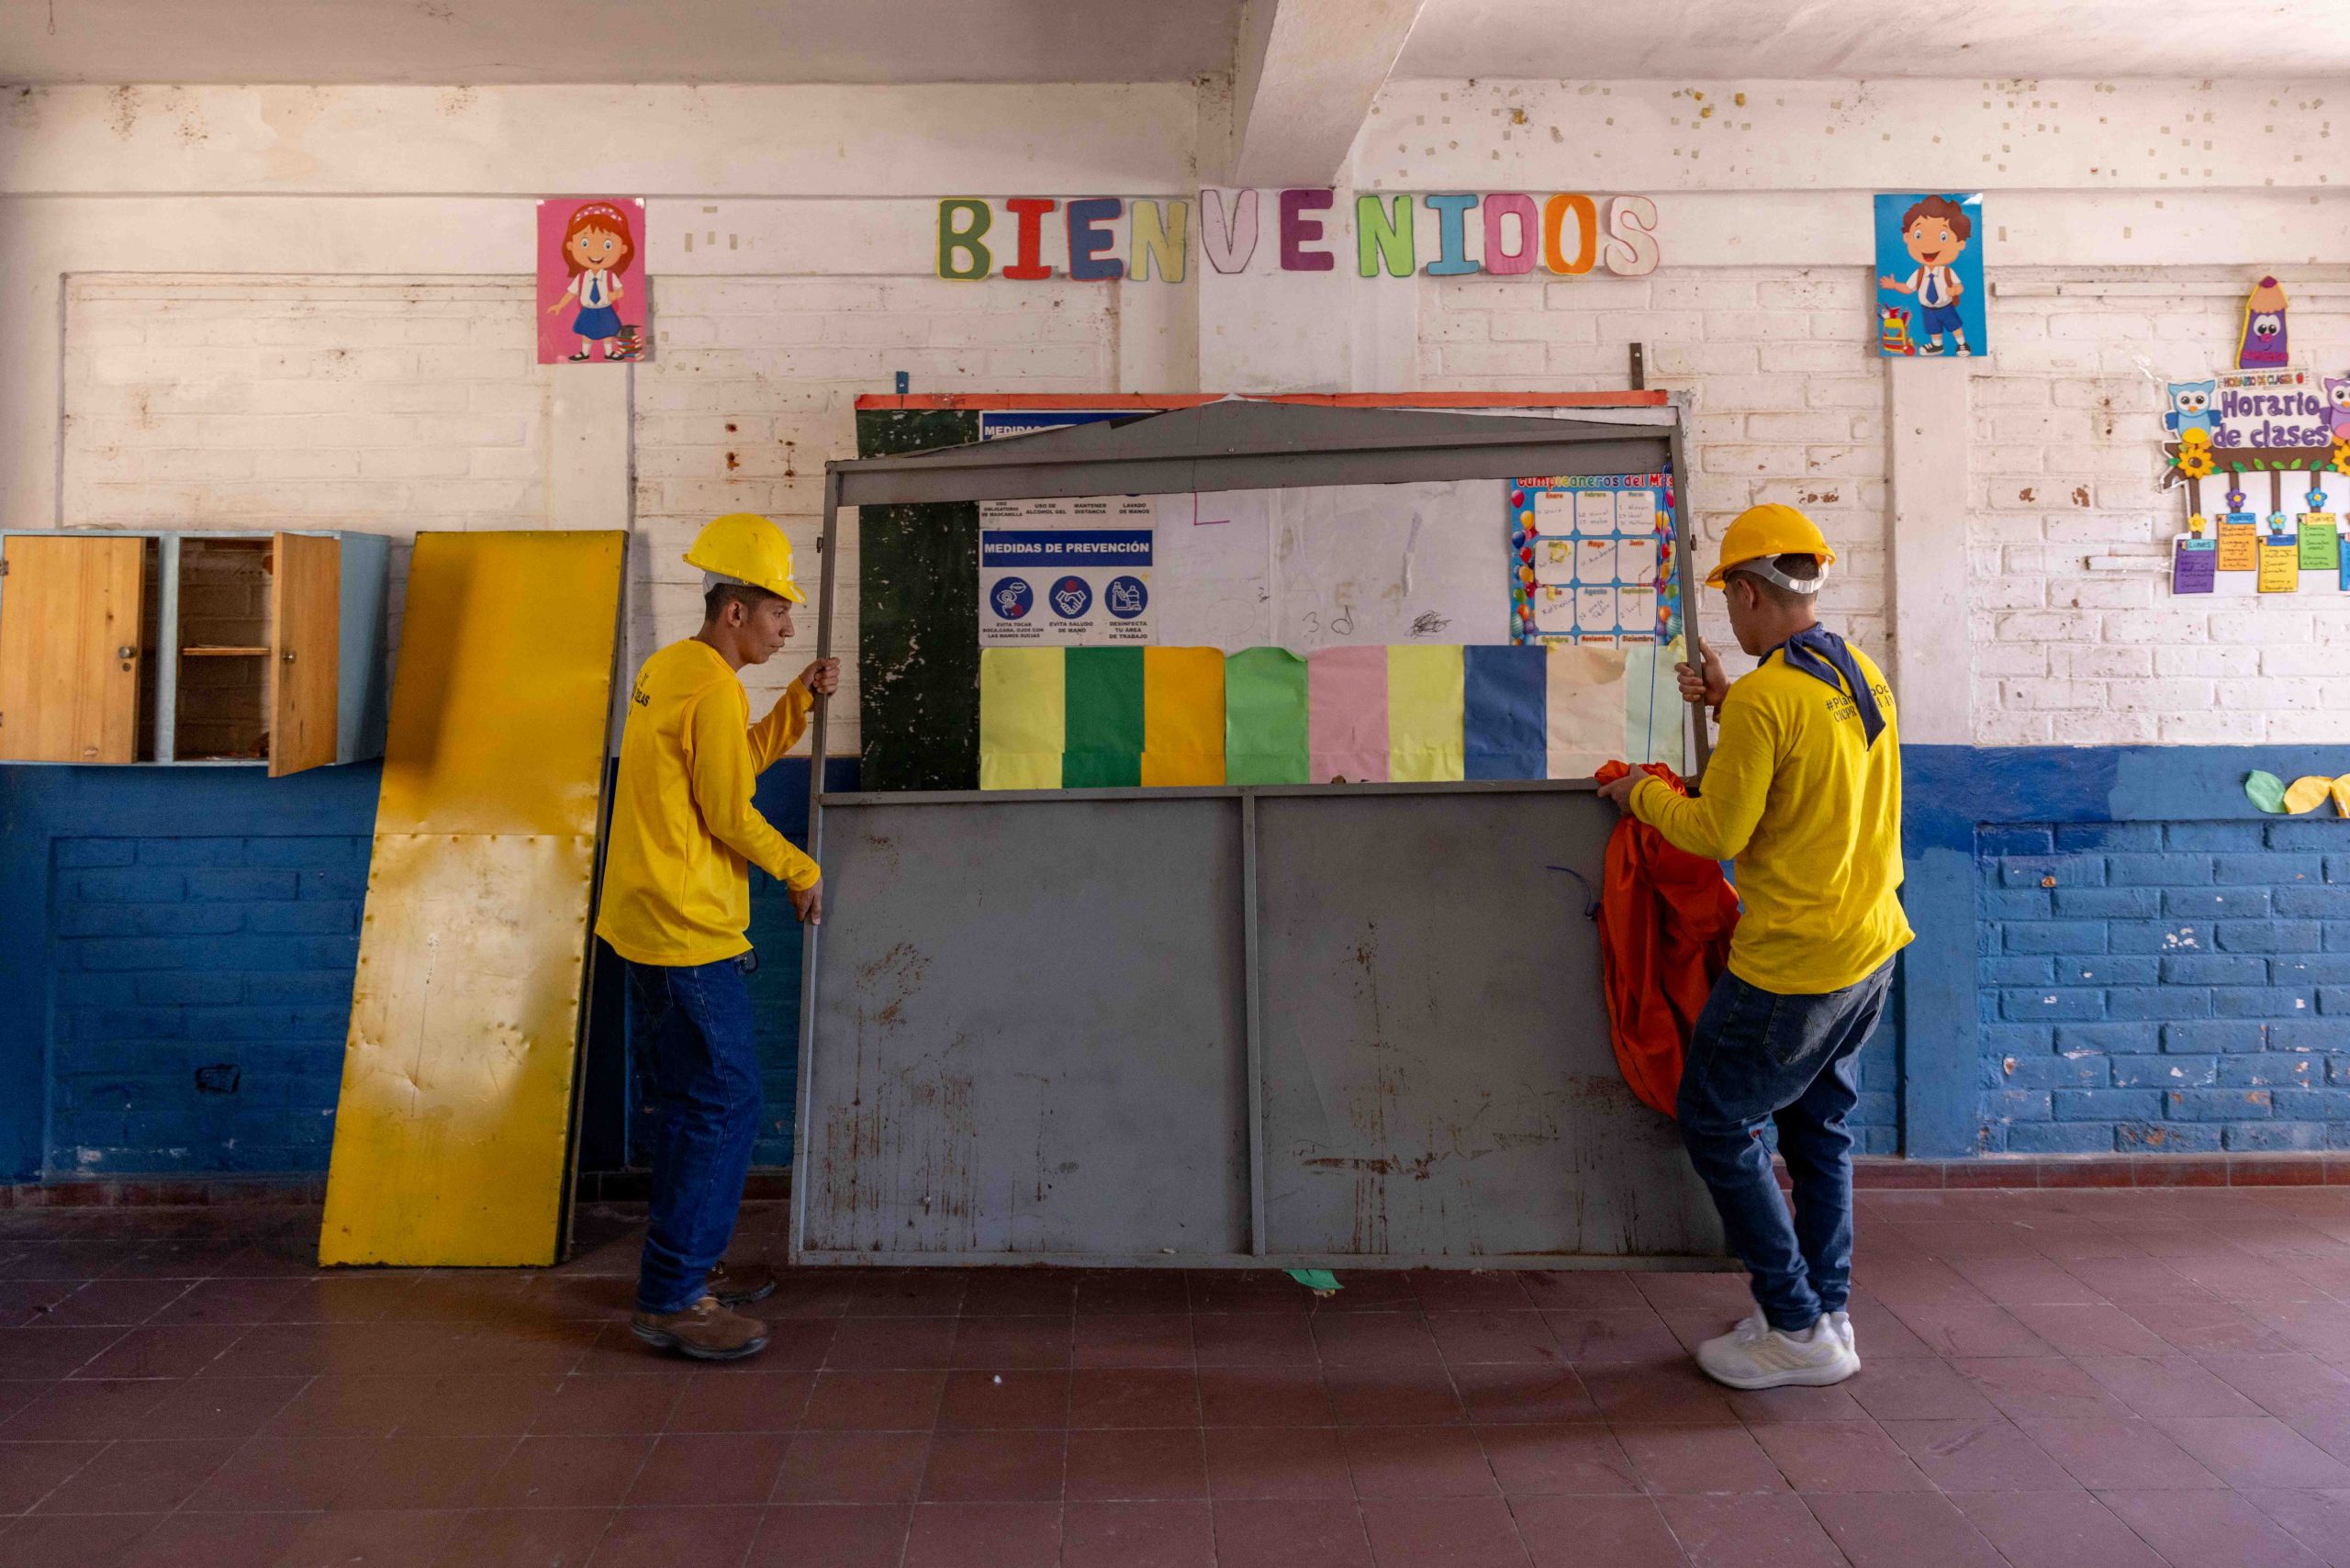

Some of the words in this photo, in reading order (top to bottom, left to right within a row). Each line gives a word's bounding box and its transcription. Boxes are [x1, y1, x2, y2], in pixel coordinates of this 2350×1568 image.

[937, 189, 1658, 282] BIENVENIDOS
[2221, 390, 2320, 418] Horario
[2213, 422, 2241, 447] de
[2250, 420, 2330, 447] clases
[1624, 474, 1645, 487] del
[984, 543, 1042, 553] MEDIDAS
[1046, 543, 1062, 553] DE
[1066, 541, 1149, 553] PREVENCIÓN
[1587, 540, 1606, 548] Mayo
[1584, 588, 1608, 596] Agosto
